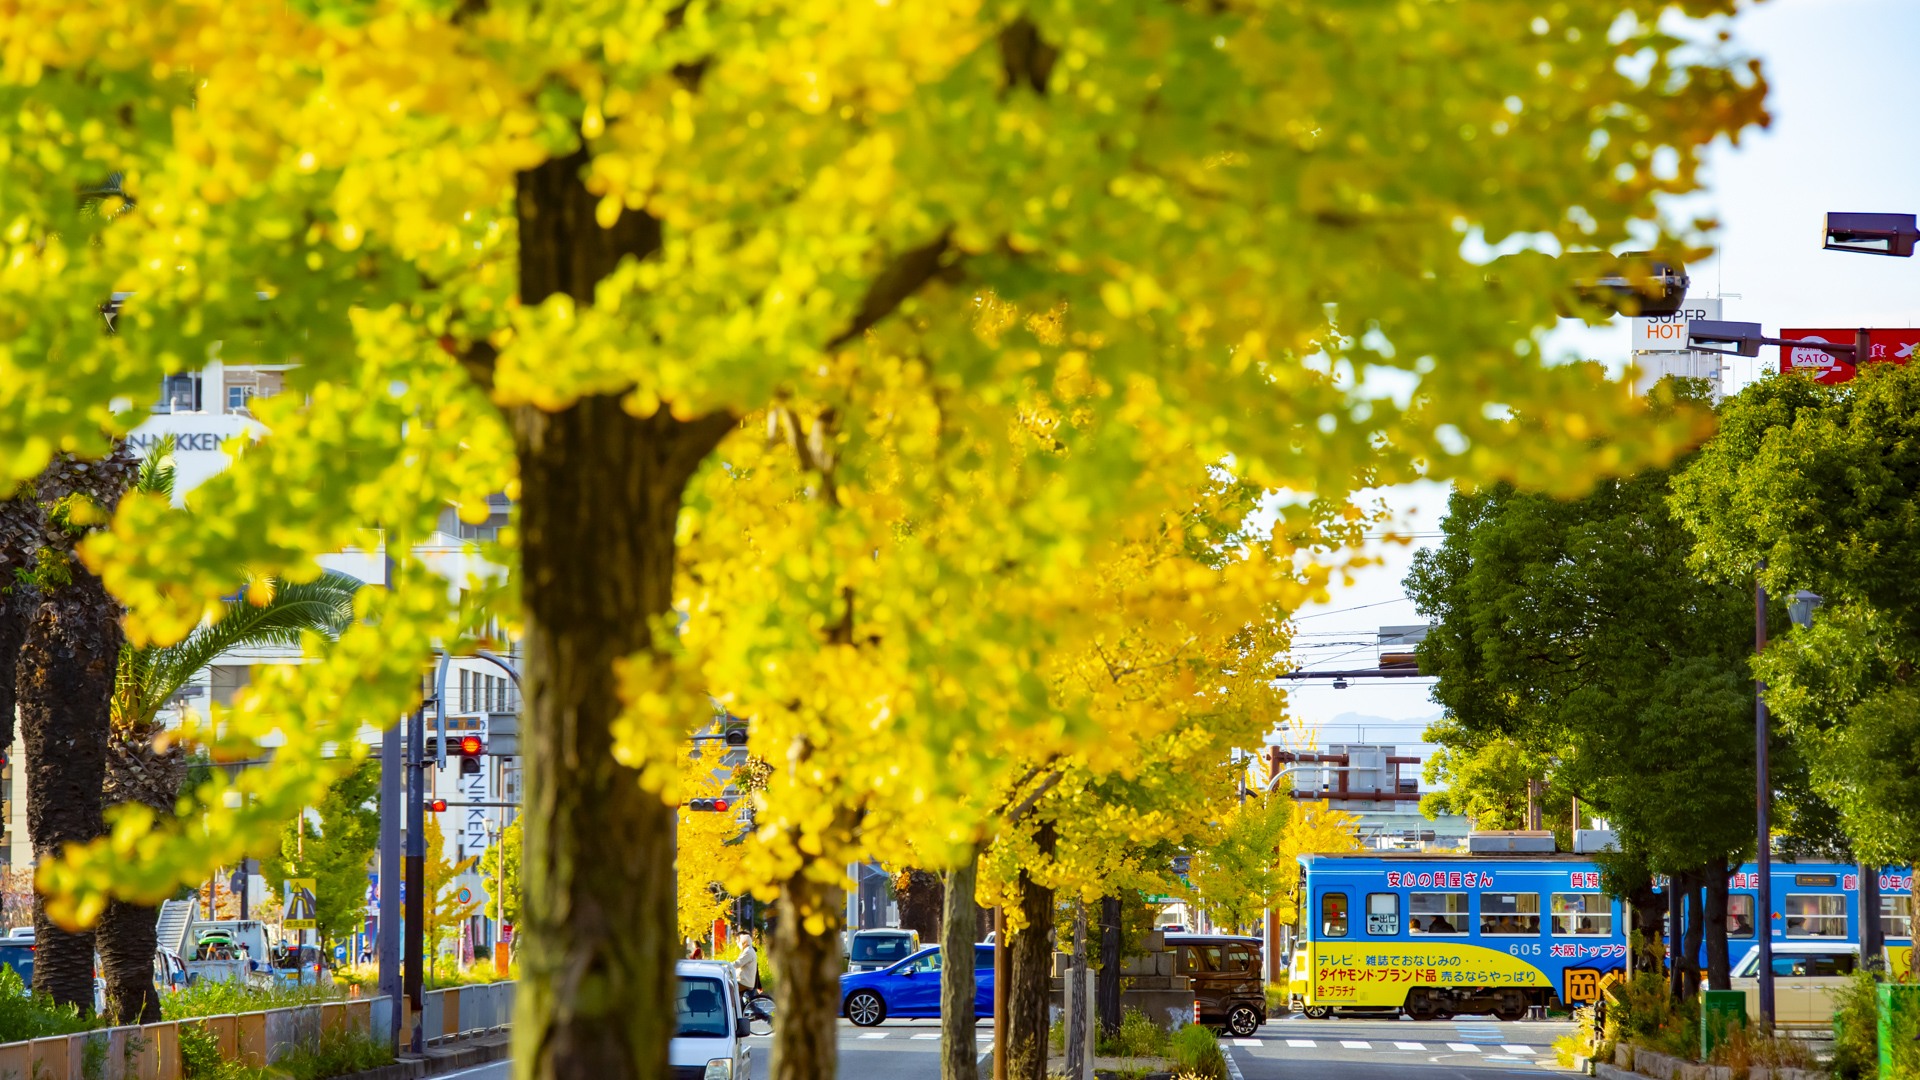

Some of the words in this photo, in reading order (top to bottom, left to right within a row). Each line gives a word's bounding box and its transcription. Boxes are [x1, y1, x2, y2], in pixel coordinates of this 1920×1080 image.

[1647, 324, 1684, 339] HOT
[1797, 353, 1829, 363] SATO
[1387, 871, 1493, 888] 安心の質屋さん
[1370, 924, 1396, 932] EXIT
[336, 947, 345, 957] P
[1510, 944, 1541, 955] 605
[1320, 968, 1436, 982] ダイヤモンド・ブランド品
[1441, 971, 1536, 982] 売るならやっぱり
[1317, 985, 1356, 997] 金・プラチナ
